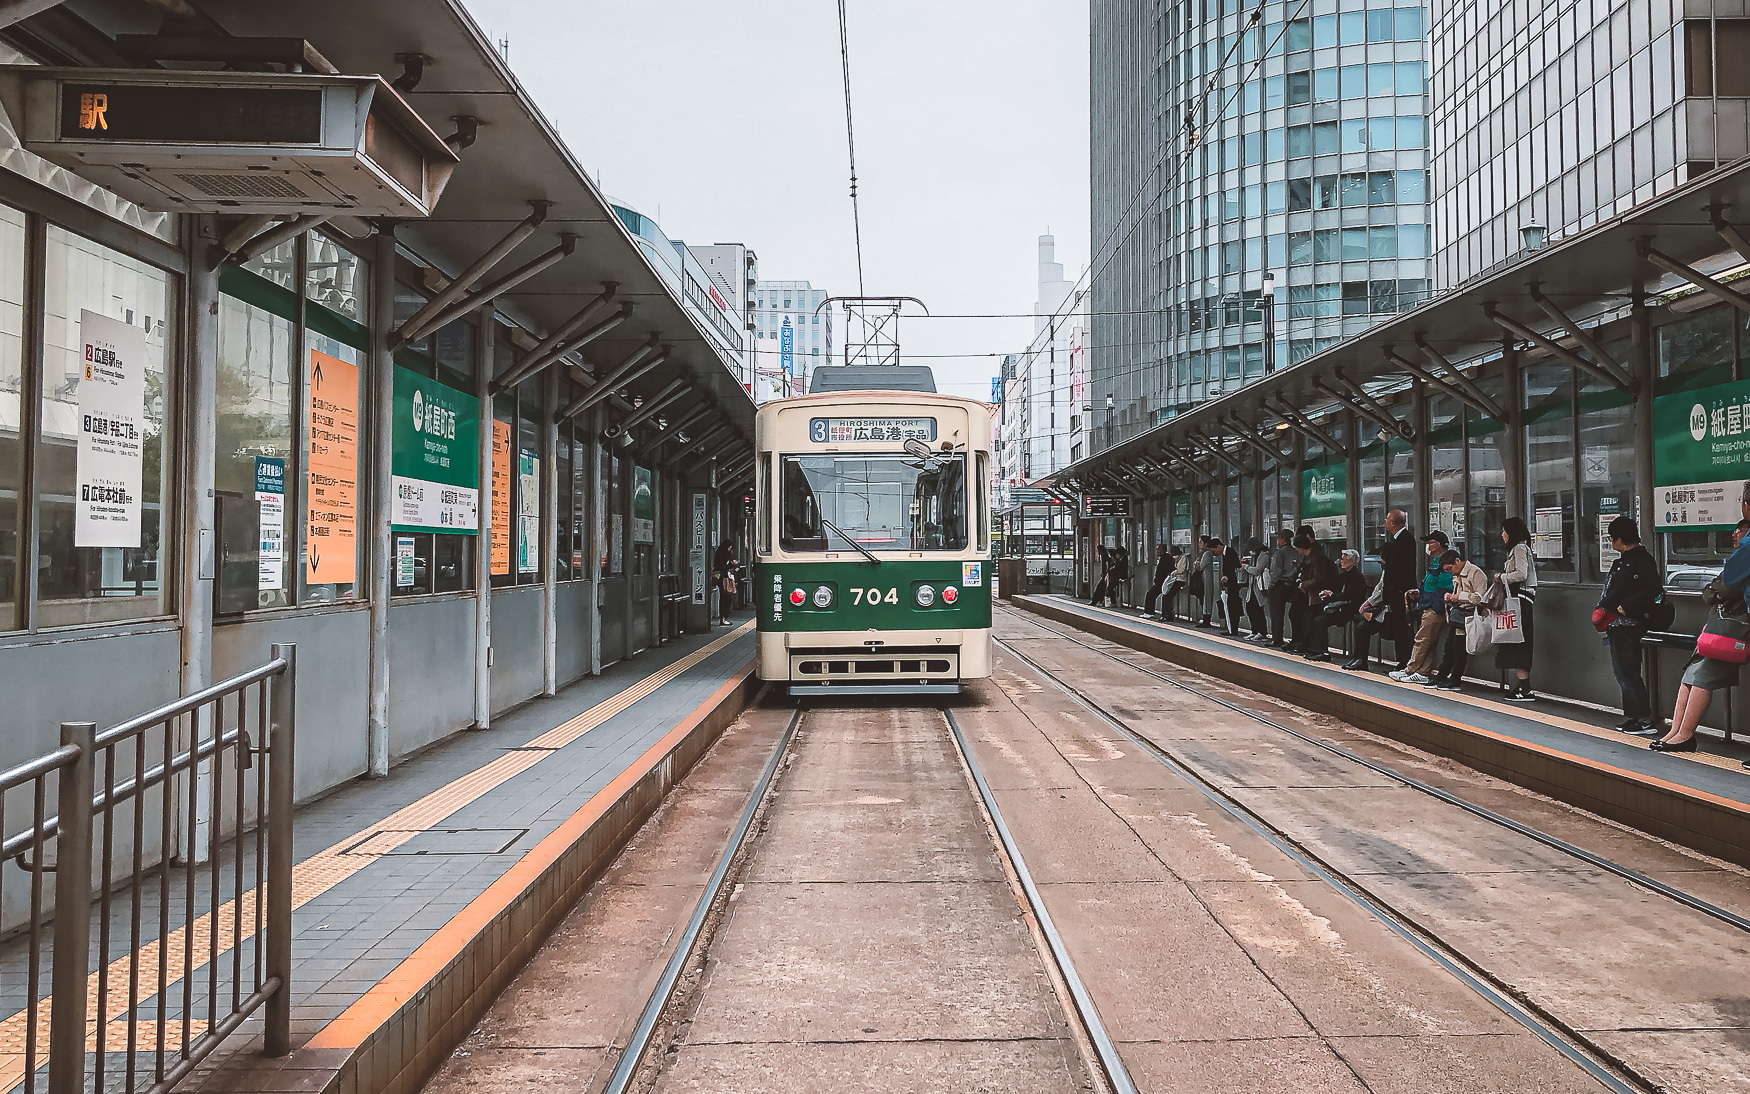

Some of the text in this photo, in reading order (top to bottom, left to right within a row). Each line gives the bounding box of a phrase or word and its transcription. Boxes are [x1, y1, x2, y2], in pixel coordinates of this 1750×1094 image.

[79, 92, 108, 131] 駅
[814, 421, 826, 442] 3
[773, 574, 783, 622] 乗降者優先
[850, 588, 899, 605] 704
